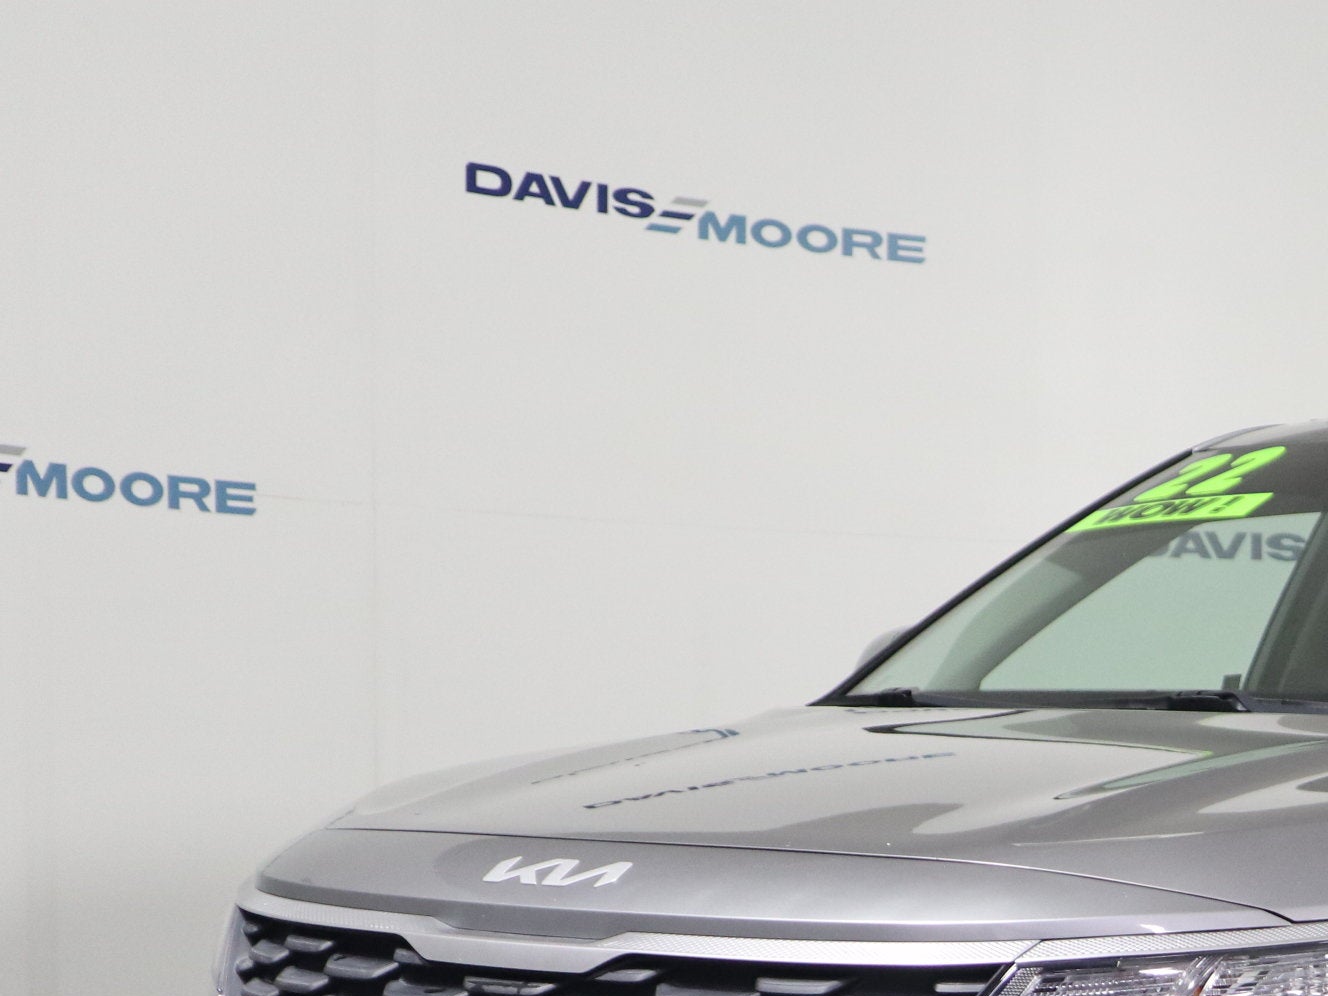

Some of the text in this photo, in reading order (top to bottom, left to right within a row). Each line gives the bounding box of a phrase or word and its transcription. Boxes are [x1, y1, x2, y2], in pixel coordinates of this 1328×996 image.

[464, 161, 927, 264] DAVIS MOORE
[16, 459, 257, 516] MOORE
[1133, 446, 1286, 501] 22
[1156, 531, 1305, 562] AVIS
[482, 855, 633, 887] KIA
